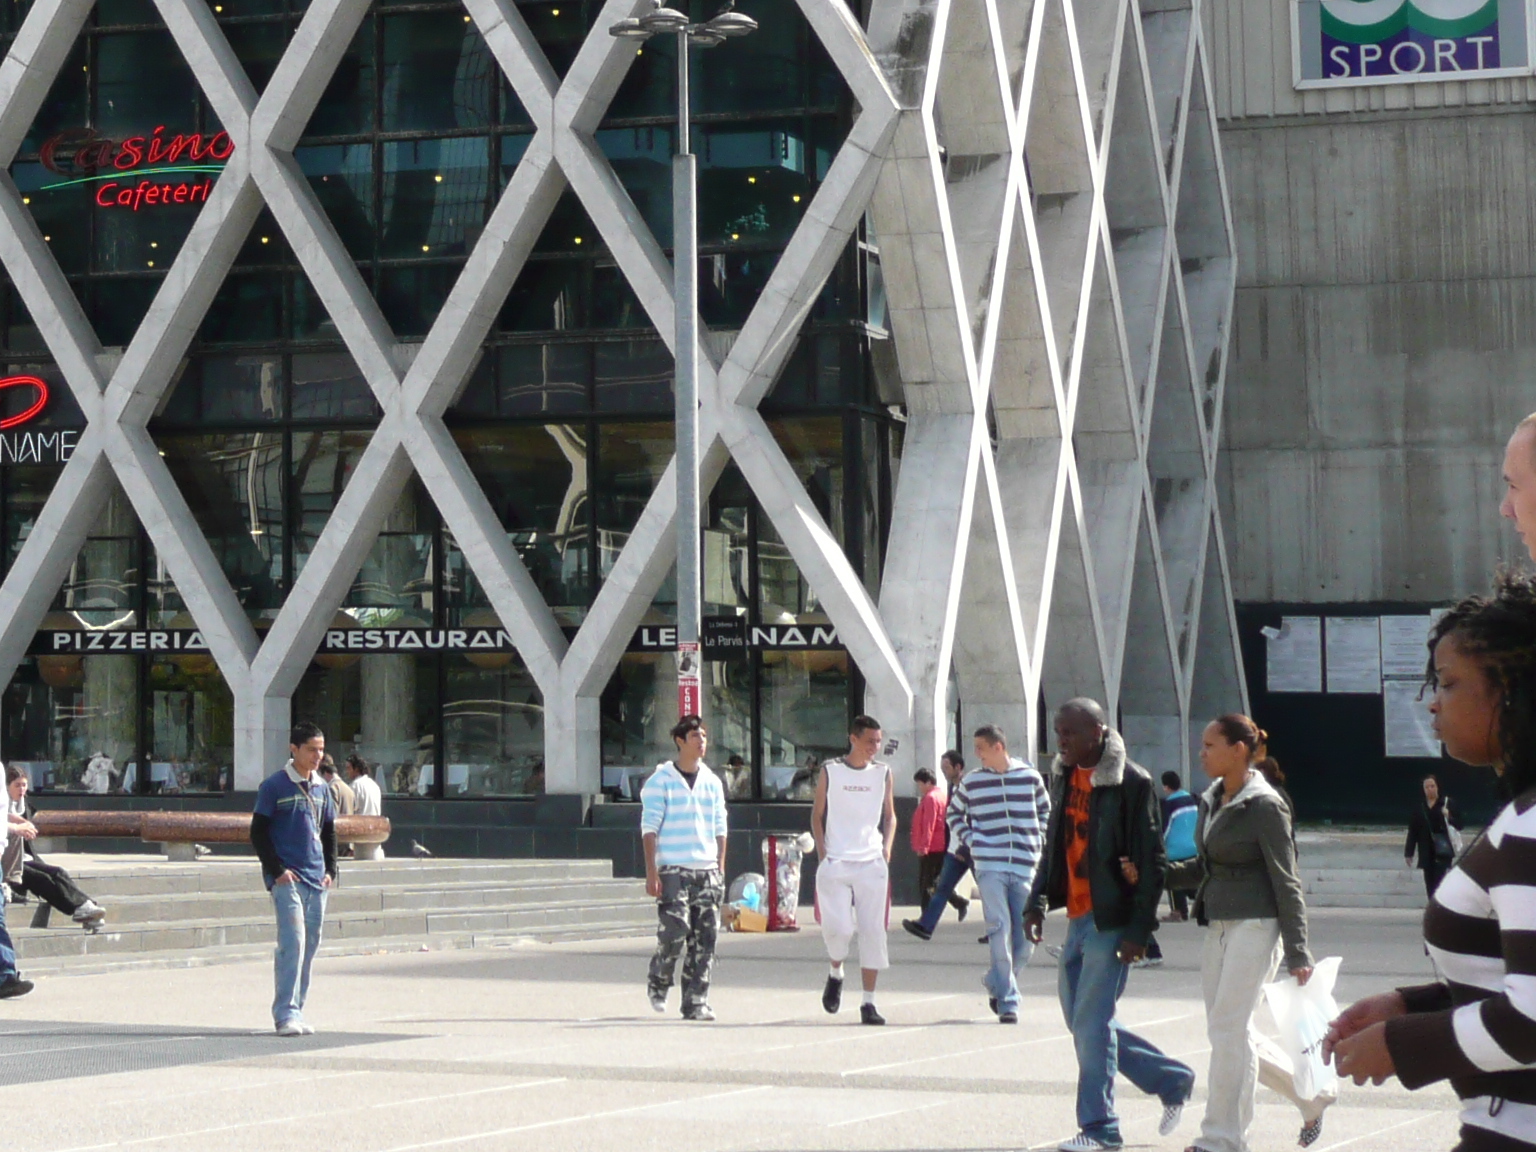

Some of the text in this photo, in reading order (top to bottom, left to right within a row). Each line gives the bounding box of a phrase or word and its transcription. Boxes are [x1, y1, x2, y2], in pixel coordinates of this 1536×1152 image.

[1329, 36, 1494, 79] SPORT
[39, 125, 236, 177] Casino
[53, 631, 208, 650] PIZZERIA
[642, 627, 677, 646] LE
[705, 635, 743, 646] Le Parvis
